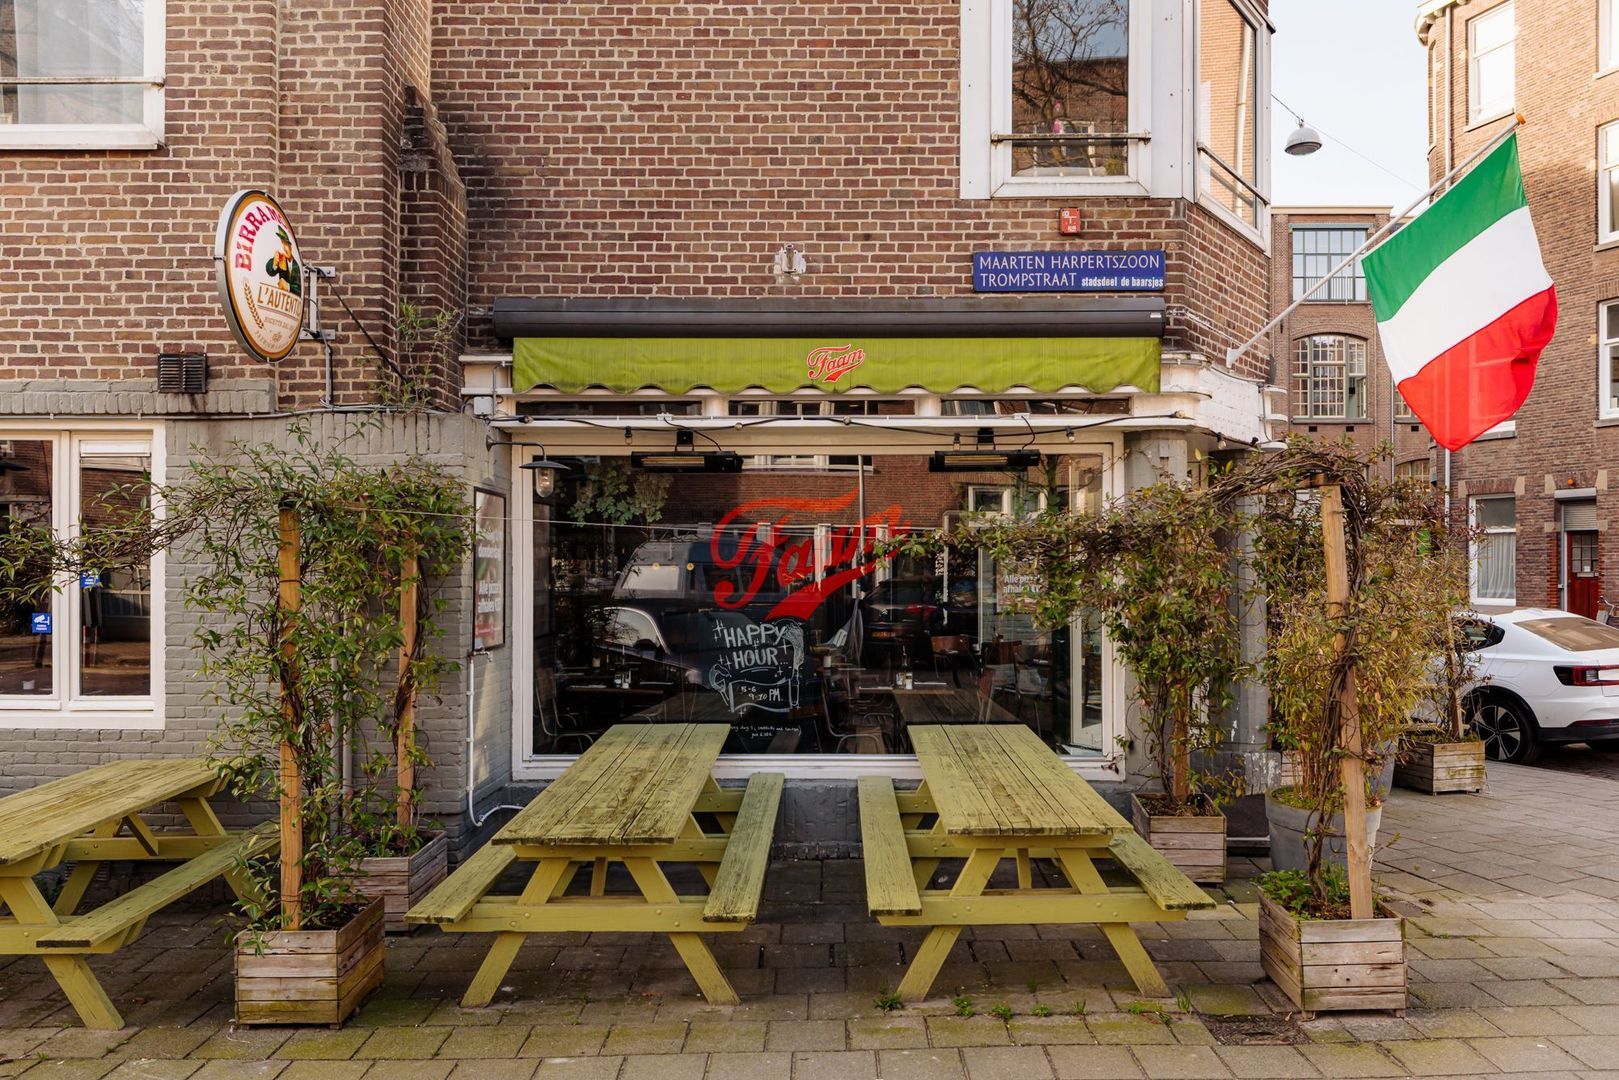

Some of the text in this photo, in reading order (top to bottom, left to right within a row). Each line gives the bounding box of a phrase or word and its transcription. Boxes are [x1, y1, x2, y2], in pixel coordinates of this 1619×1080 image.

[979, 254, 1160, 270] MAARTEN HARPERTSZOON
[979, 272, 1164, 288] TROMPSTRAAT stadsdeel de baarsjes
[807, 343, 866, 382] Faam
[723, 623, 787, 649] HAPPY
